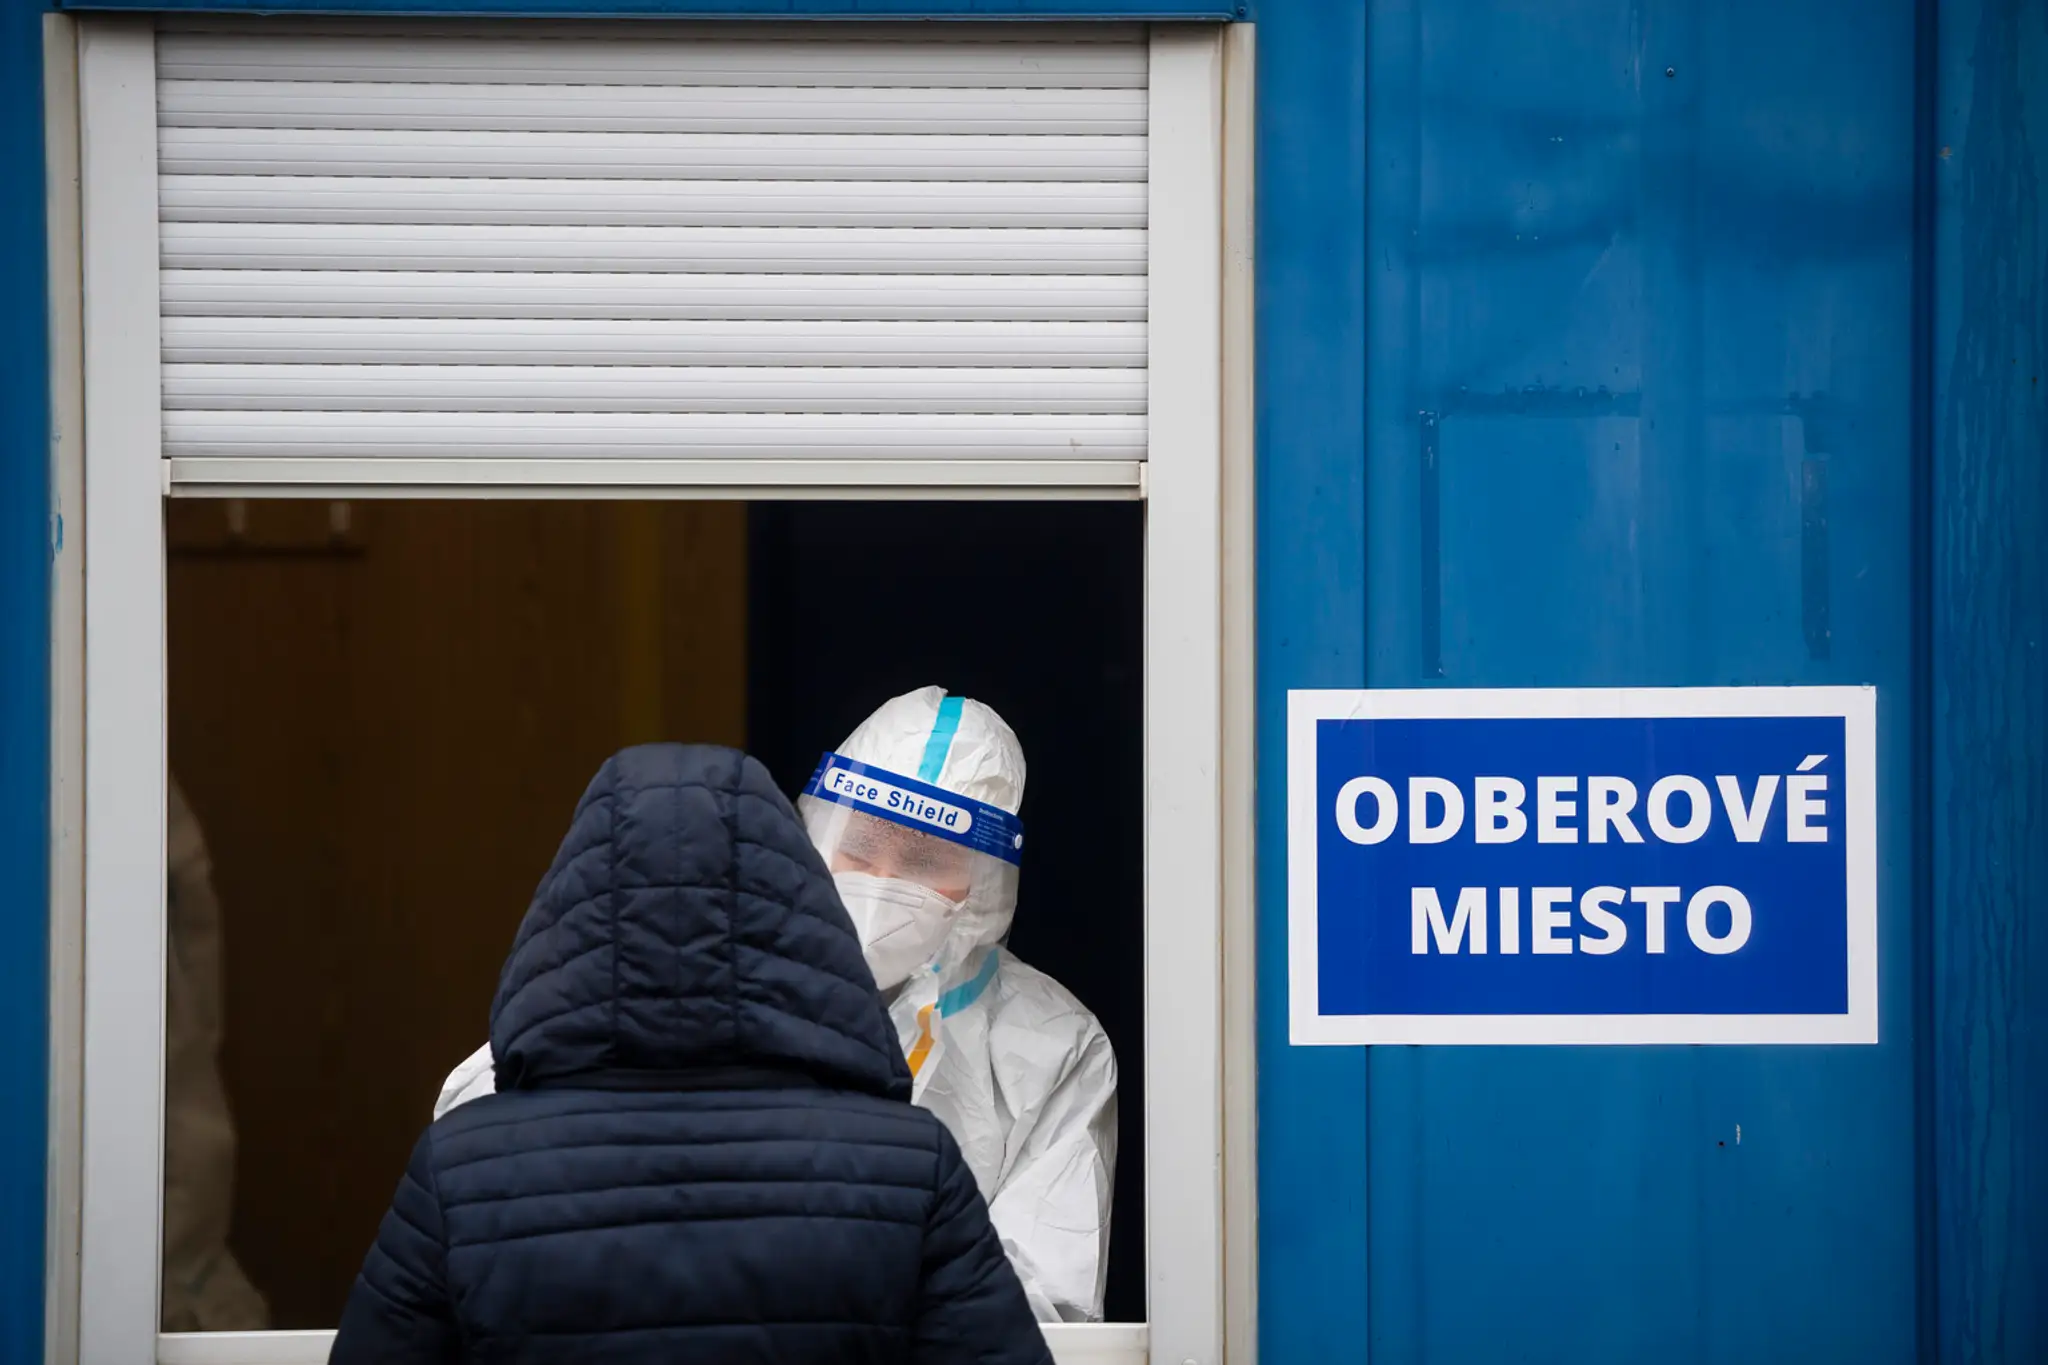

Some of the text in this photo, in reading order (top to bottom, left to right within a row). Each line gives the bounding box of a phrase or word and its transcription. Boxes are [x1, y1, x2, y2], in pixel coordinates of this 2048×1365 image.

[833, 773, 959, 827] Face Shield
[1335, 754, 1829, 845] ODBEROVÉ
[1411, 885, 1752, 955] MIESTO
